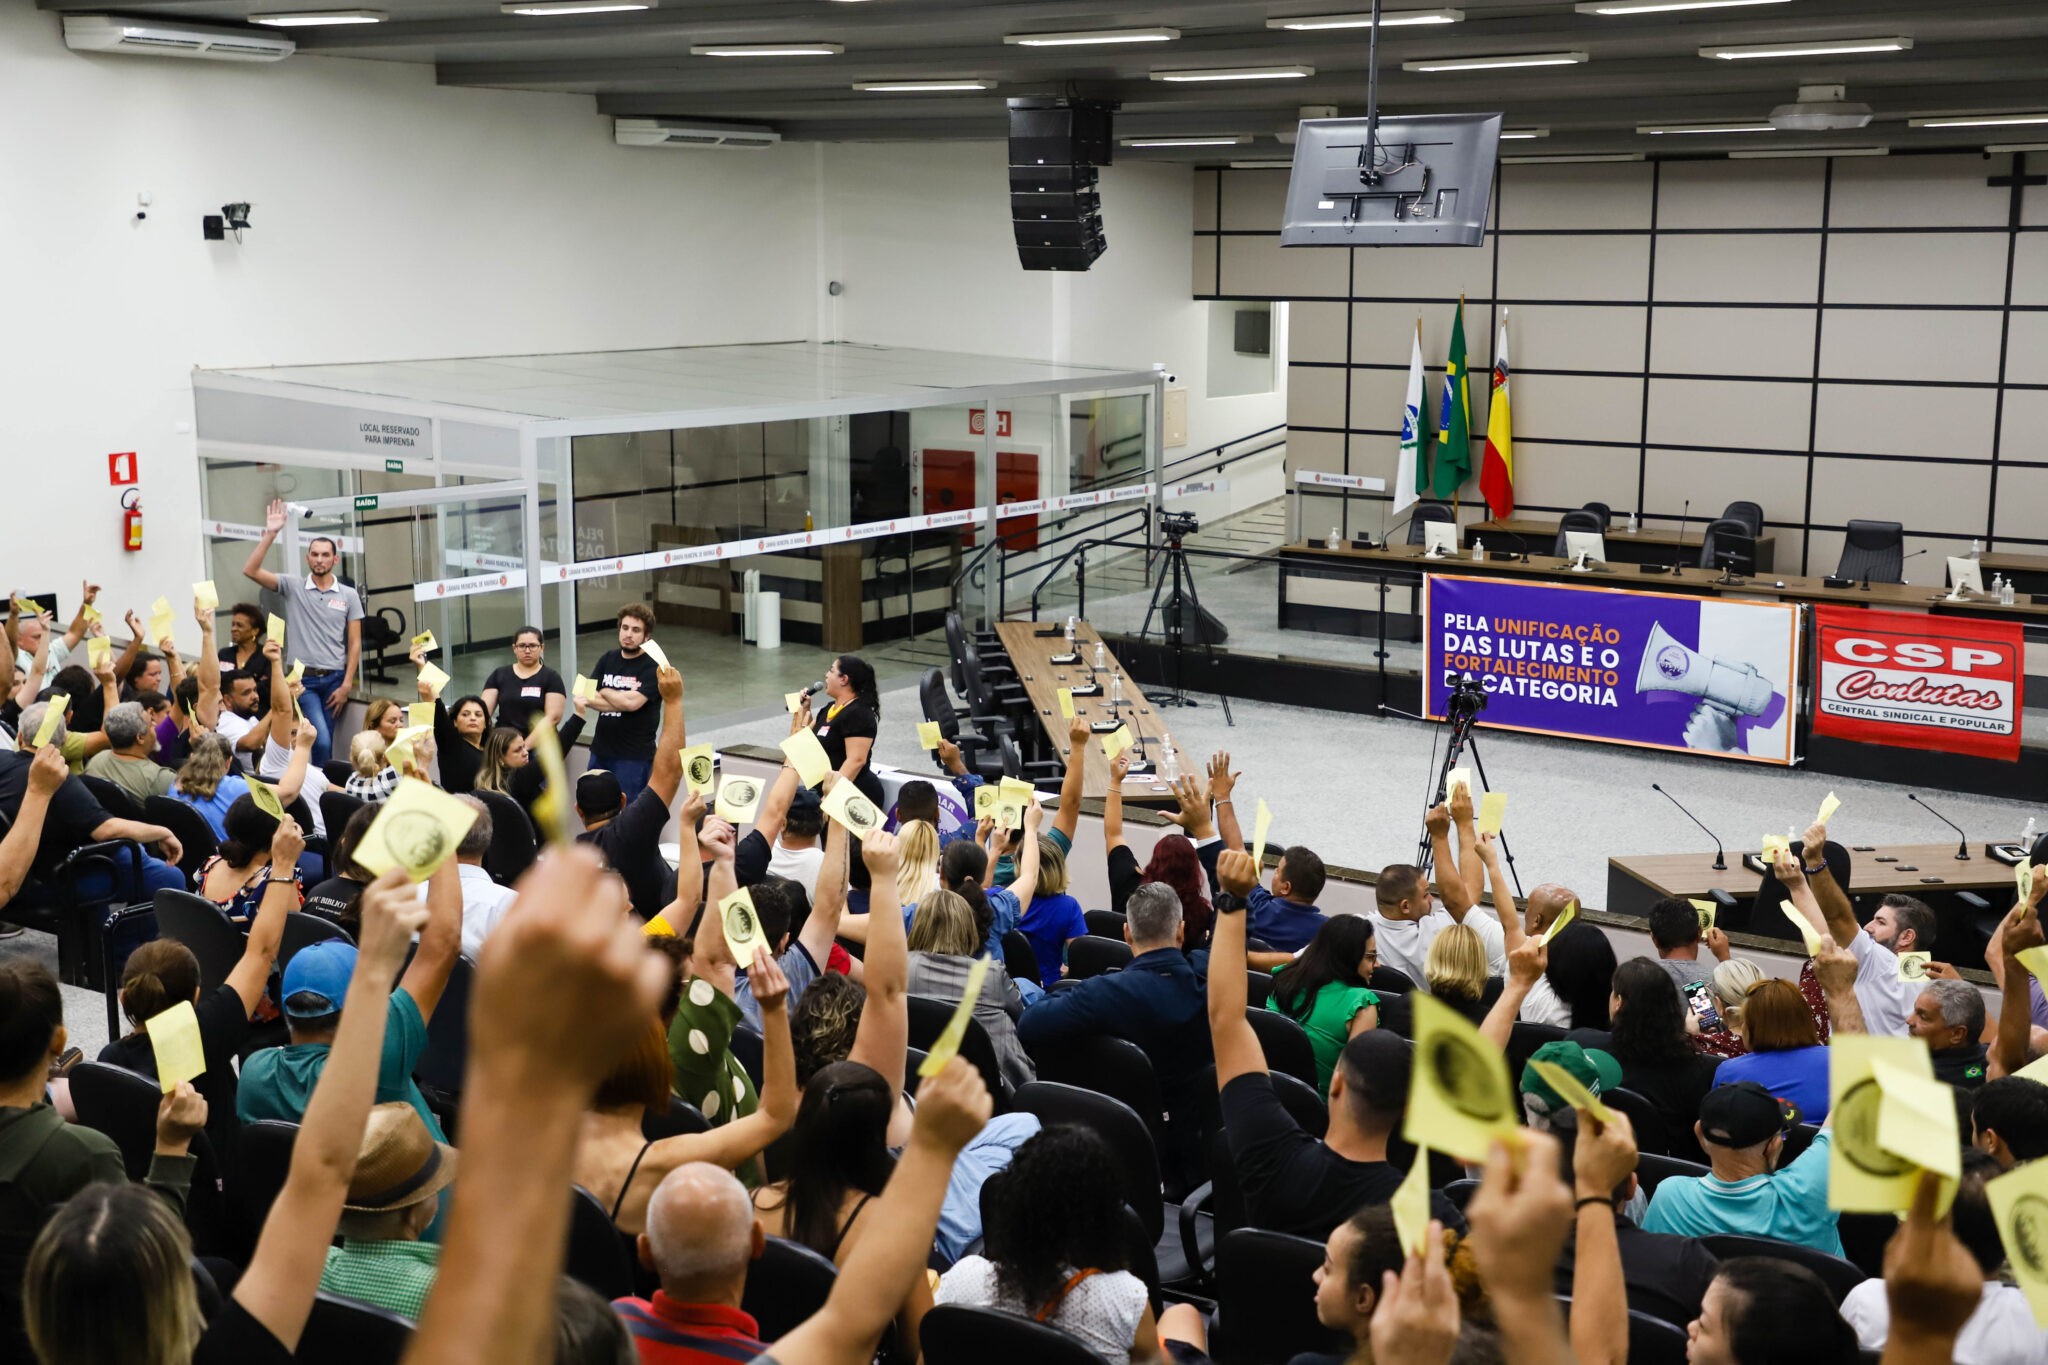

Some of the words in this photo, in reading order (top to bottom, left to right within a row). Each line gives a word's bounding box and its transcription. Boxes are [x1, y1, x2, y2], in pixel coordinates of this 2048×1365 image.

[360, 423, 380, 432] LOCAL
[382, 425, 420, 437] RESERVADO
[365, 434, 381, 444] PARA
[383, 436, 415, 447] IMPRENSA
[387, 461, 402, 469] SAÍDA
[356, 498, 376, 507] SAÍDA
[1444, 613, 1489, 632] PELA
[1494, 617, 1620, 647] UNIFICAÇÃO
[1444, 632, 1492, 655] DAS
[1499, 637, 1574, 664] LUTAS
[1581, 646, 1593, 667] E
[1600, 648, 1620, 669] O
[1834, 637, 2003, 672] CSP
[1444, 653, 1619, 686] FORTALECIMENTO
[1482, 674, 1618, 707] CATEGORIA
[1837, 670, 2002, 710] Conlutas
[1828, 703, 1879, 717] CENTRAL
[1882, 710, 1936, 723] SINDICAL
[1940, 716, 1946, 724] E
[1950, 717, 2005, 731] POPULAR
